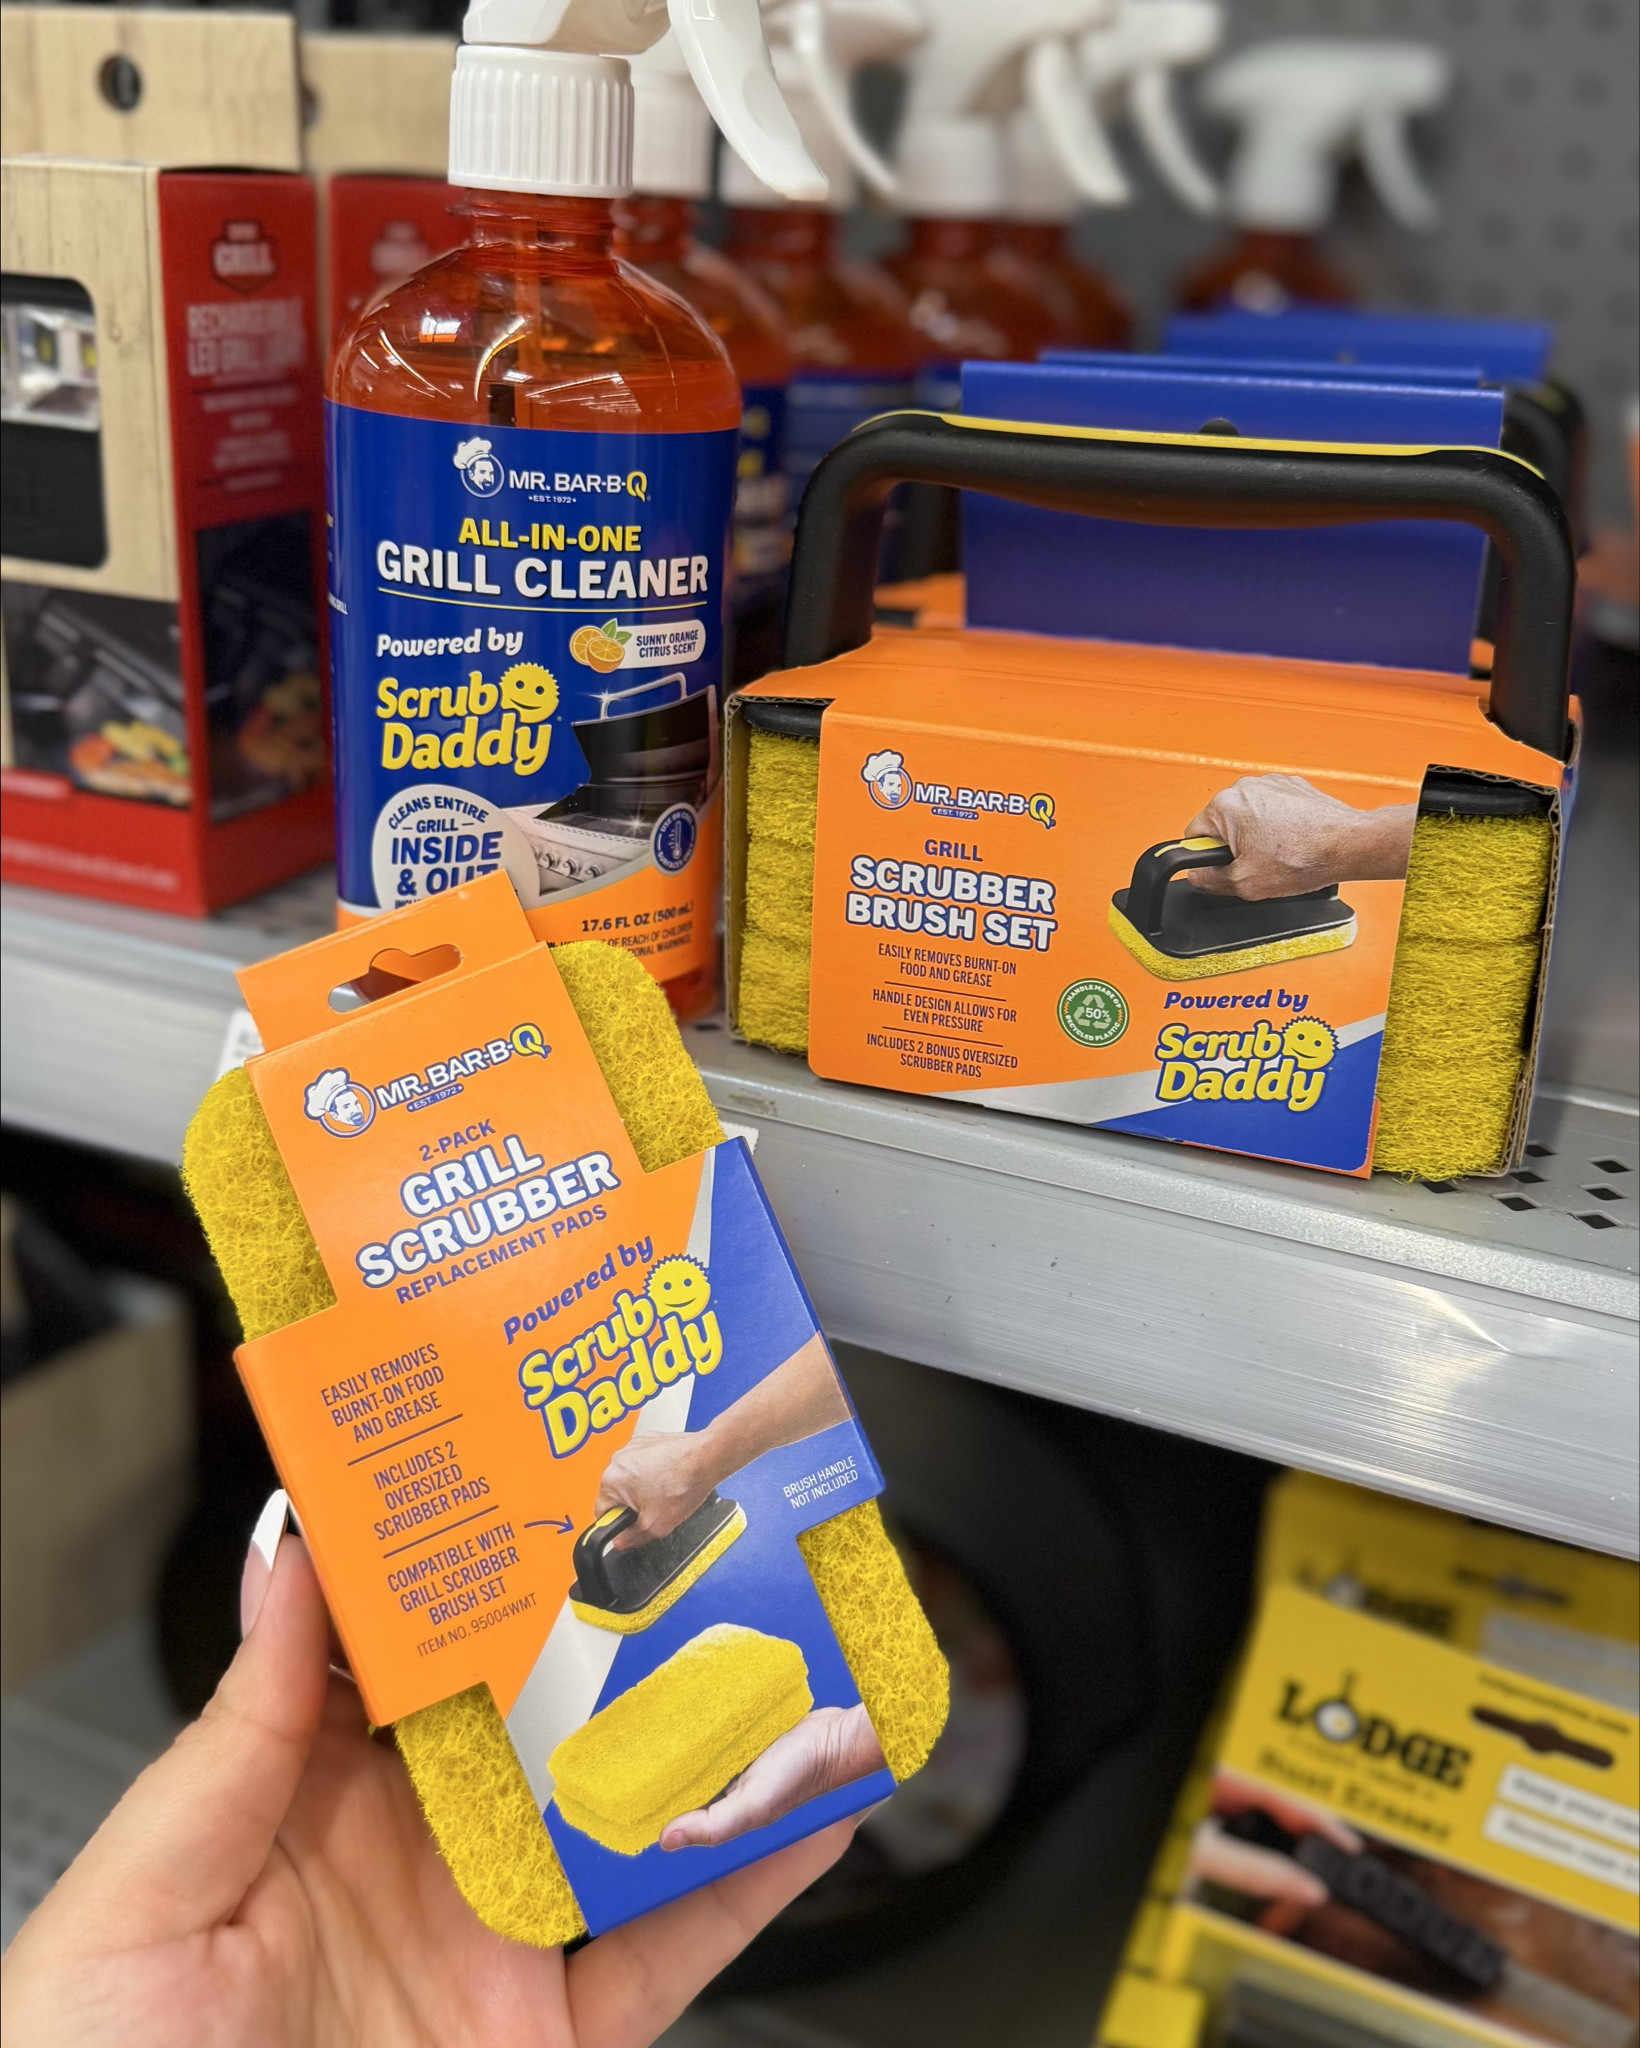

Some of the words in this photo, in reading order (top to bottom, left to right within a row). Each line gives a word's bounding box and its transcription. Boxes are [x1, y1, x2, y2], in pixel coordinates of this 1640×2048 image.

[509, 470, 551, 491] MR.
[554, 471, 647, 502] BAR-B-Q
[458, 517, 642, 552] ALL-IN-ONE
[376, 540, 501, 595] GRILL
[513, 555, 709, 599] CLEANER
[376, 627, 482, 658] Powered
[486, 626, 523, 655] by
[636, 633, 668, 646] SUNNY
[669, 629, 699, 643] ORANGE
[639, 645, 671, 658] CITRUS
[673, 641, 697, 655] SCENT
[375, 671, 499, 719] Scrub
[380, 709, 552, 776] Daddy
[388, 796, 432, 831] CLEANS
[434, 795, 489, 824] ENTIRE
[416, 818, 459, 833] GRILL
[914, 783, 954, 805] MR.
[956, 788, 1055, 829] BAR-B-Q
[955, 809, 974, 819] 1972
[391, 830, 504, 865] INSIDE
[924, 839, 983, 862] GRILL
[397, 868, 417, 896] &
[851, 855, 1055, 914] SCRUBBER
[582, 918, 612, 932] 17.6
[615, 917, 631, 929] FL
[634, 913, 651, 926] OZ
[653, 907, 677, 923] (500
[621, 934, 650, 947] REACH
[651, 931, 662, 942] OF
[846, 891, 976, 940] BRUSH
[982, 909, 1058, 952] SET
[878, 943, 912, 960] EASILY
[914, 948, 962, 967] REMOVES
[964, 953, 1017, 975] BURNT-ON
[900, 962, 927, 978] FOOD
[928, 966, 951, 981] AND
[952, 969, 993, 988] GREASE
[872, 988, 913, 1006] HANDLE
[914, 994, 952, 1011] DESIGN
[953, 999, 995, 1019] ALLOWS
[997, 1006, 1017, 1022] FOR
[1066, 984, 1093, 1002] HANDLE
[1094, 985, 1115, 999] MADE
[1113, 998, 1122, 1008] OF
[1085, 1007, 1110, 1019] 50%
[1164, 990, 1270, 1009] Powered
[1276, 989, 1308, 1012] by
[903, 1008, 930, 1024] EVEN
[931, 1013, 984, 1033] PRESSURE
[1065, 1014, 1094, 1041] RECYCLED
[1094, 1022, 1121, 1041] PLASTIC
[1155, 1020, 1282, 1060] Scrub
[374, 1074, 430, 1109] MR.
[426, 1023, 549, 1089] BAR-B-Q
[866, 1033, 915, 1051] INCLUDES
[917, 1041, 924, 1053] 2
[926, 1041, 960, 1060] BONUS
[962, 1048, 1018, 1069] OVERSIZED
[900, 1054, 953, 1074] SCRUBBER
[955, 1062, 982, 1078] PADS
[412, 1095, 436, 1110] EST.
[435, 1085, 459, 1101] 1972
[1157, 1058, 1326, 1112] Daddy
[418, 1118, 496, 1161] 2-PACK
[400, 1134, 544, 1217] GRILL
[356, 1150, 622, 1288] SCRUBBER
[395, 1227, 548, 1304] REPLACEMENT
[551, 1204, 608, 1239] PADS
[503, 1252, 618, 1345] Powered
[617, 1235, 654, 1267] by
[519, 1289, 655, 1410] Scrub
[320, 1372, 368, 1406] EASILY
[370, 1343, 439, 1385] REMOVES
[541, 1311, 723, 1459] Daddy
[331, 1385, 406, 1427] BURNT-ON
[405, 1365, 445, 1394] FOOD
[352, 1418, 384, 1443] AND
[387, 1391, 442, 1429] GREASE
[373, 1450, 445, 1490] INCLUDES
[445, 1441, 458, 1459] 2
[783, 1474, 818, 1498] BRUSH
[817, 1455, 857, 1481] HANDLE
[384, 1463, 463, 1510] OVERSIZED
[790, 1493, 811, 1509] NOT
[811, 1469, 859, 1500] INCLUDED
[373, 1495, 451, 1541] SCRUBBER
[451, 1476, 491, 1506] PADS
[387, 1540, 478, 1592] COMPATIBLE
[475, 1522, 516, 1551] WITH
[399, 1581, 444, 1613] GRILL
[442, 1546, 520, 1594] SCRUBBER
[428, 1593, 479, 1626] BRUSH
[479, 1576, 507, 1602] SET
[416, 1637, 448, 1658] ITEM
[447, 1624, 472, 1644] NO.
[470, 1592, 538, 1634] 95004WMT
